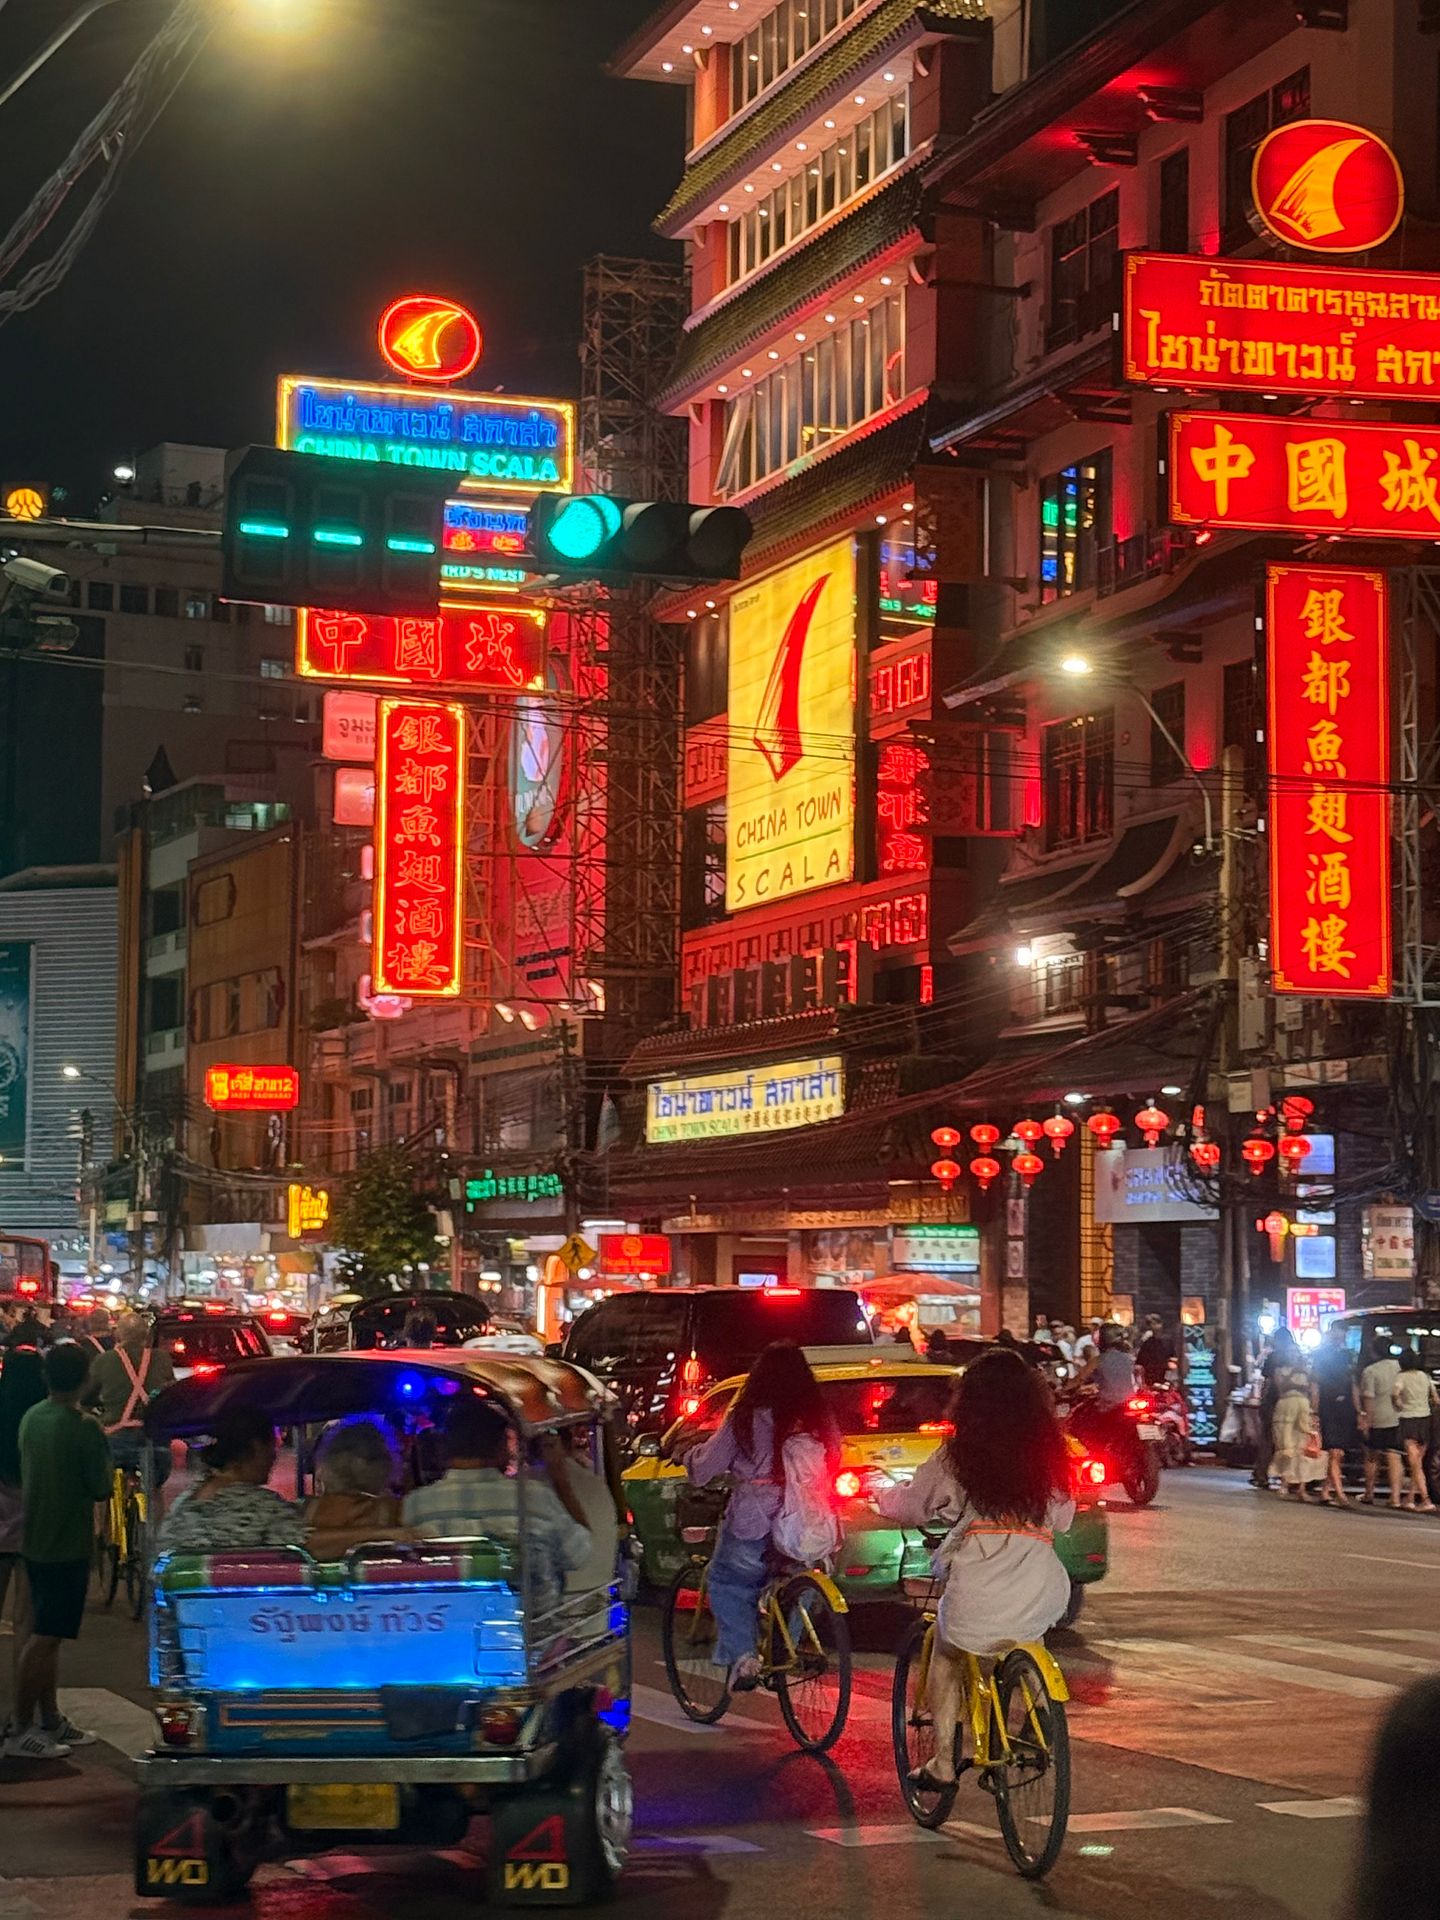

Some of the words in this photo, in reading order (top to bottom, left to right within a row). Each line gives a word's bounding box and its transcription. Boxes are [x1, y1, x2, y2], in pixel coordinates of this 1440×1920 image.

[1139, 308, 1356, 382] ไชน่าทาวน์
[299, 387, 452, 441] ไชน่าทาวน์
[462, 410, 558, 448] สกาล่า
[296, 437, 380, 462] CHINA
[388, 444, 467, 472] TOWN
[472, 452, 560, 482] SCALA
[1190, 424, 1440, 523] 中國城
[442, 565, 485, 579] IRD'S
[314, 612, 523, 687] 中國城
[1297, 588, 1356, 979] 銀都魚翅酒樓
[736, 808, 788, 848] CHINA
[796, 786, 841, 829] TOWN
[387, 715, 453, 985] 銀都魚翅酒樓
[735, 848, 840, 903] SCALA
[379, 1604, 451, 1633] ทัวร์
[147, 1858, 208, 1885] WD
[504, 1862, 569, 1890] WD
